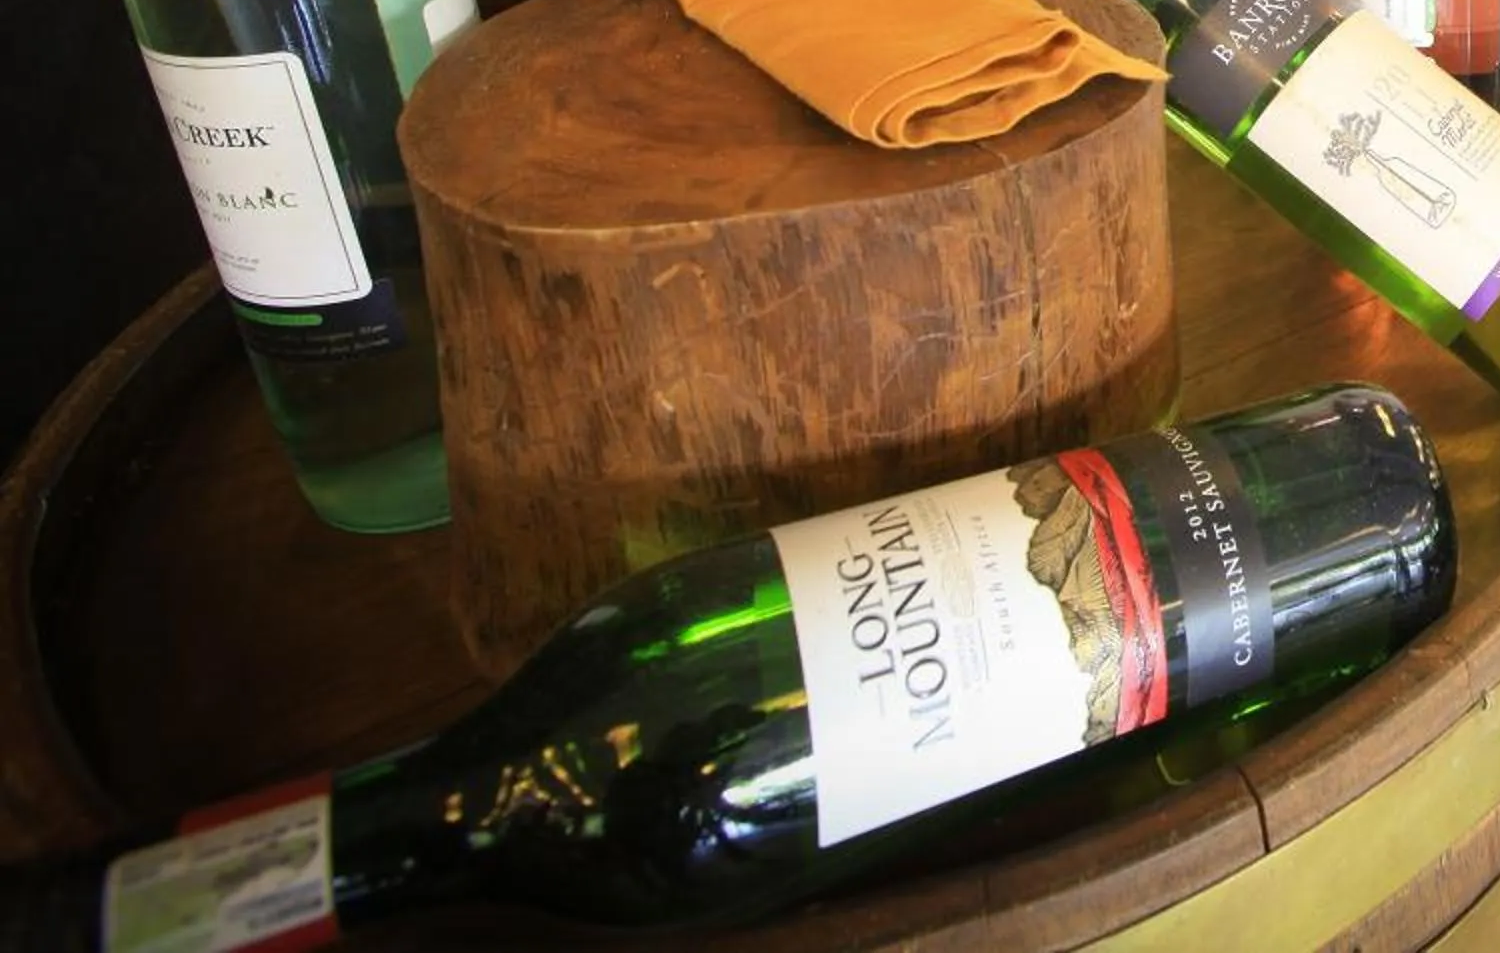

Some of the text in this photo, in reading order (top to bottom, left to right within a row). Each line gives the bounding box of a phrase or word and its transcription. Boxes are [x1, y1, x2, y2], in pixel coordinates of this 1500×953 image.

[172, 115, 271, 149] CREEK
[1179, 490, 1207, 542] 2012
[837, 552, 896, 684] LONG
[863, 505, 955, 751] MOUNTAIN
[1212, 522, 1253, 666] CABERNET
